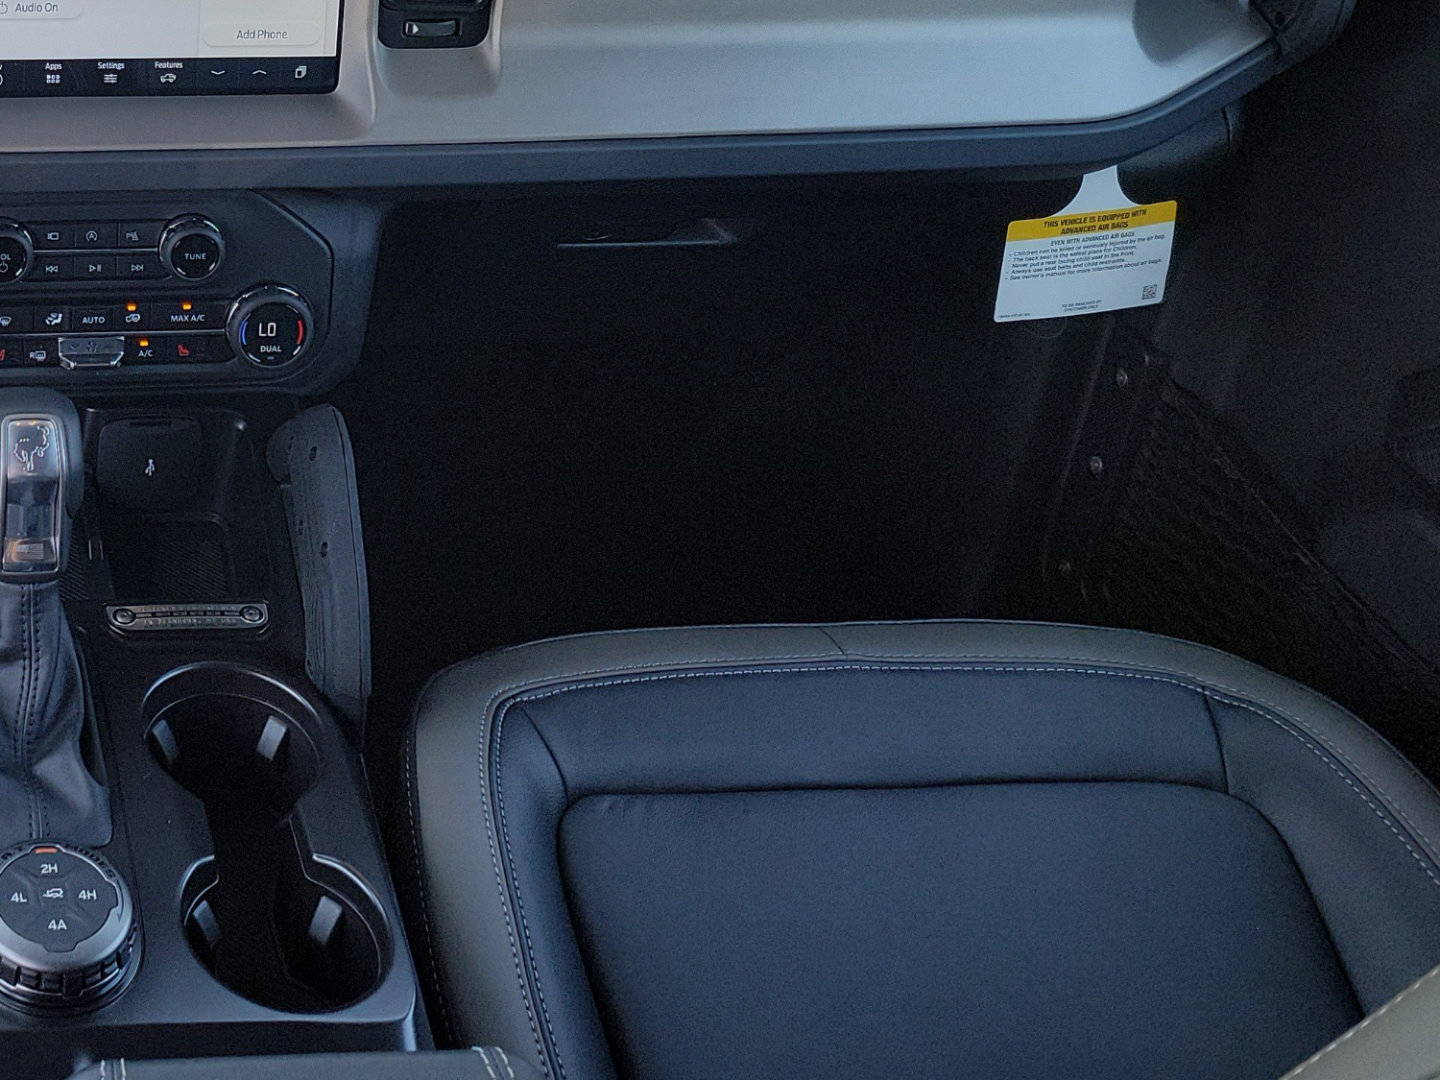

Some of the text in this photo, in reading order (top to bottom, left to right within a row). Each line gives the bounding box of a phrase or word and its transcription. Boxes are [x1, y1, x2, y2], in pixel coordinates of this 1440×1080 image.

[15, 3, 58, 13] Audio On
[236, 29, 288, 40] Add Phone
[45, 62, 62, 71] Apps
[98, 62, 124, 70] Settings
[154, 62, 183, 70] Features
[1060, 217, 1087, 226] VEHICLE
[1098, 212, 1130, 222] EQUIPPED
[1060, 225, 1096, 234] ADVANCED
[1111, 221, 1128, 230] BAGS
[184, 252, 207, 260] TUNE
[82, 316, 106, 324] AUTO
[170, 314, 205, 322] MAX A/C
[259, 322, 277, 337] LO
[260, 344, 282, 352] DUAL
[40, 864, 58, 874] 2H
[10, 892, 28, 902] 4L
[78, 890, 97, 900] 4H
[48, 920, 68, 930] 4A
